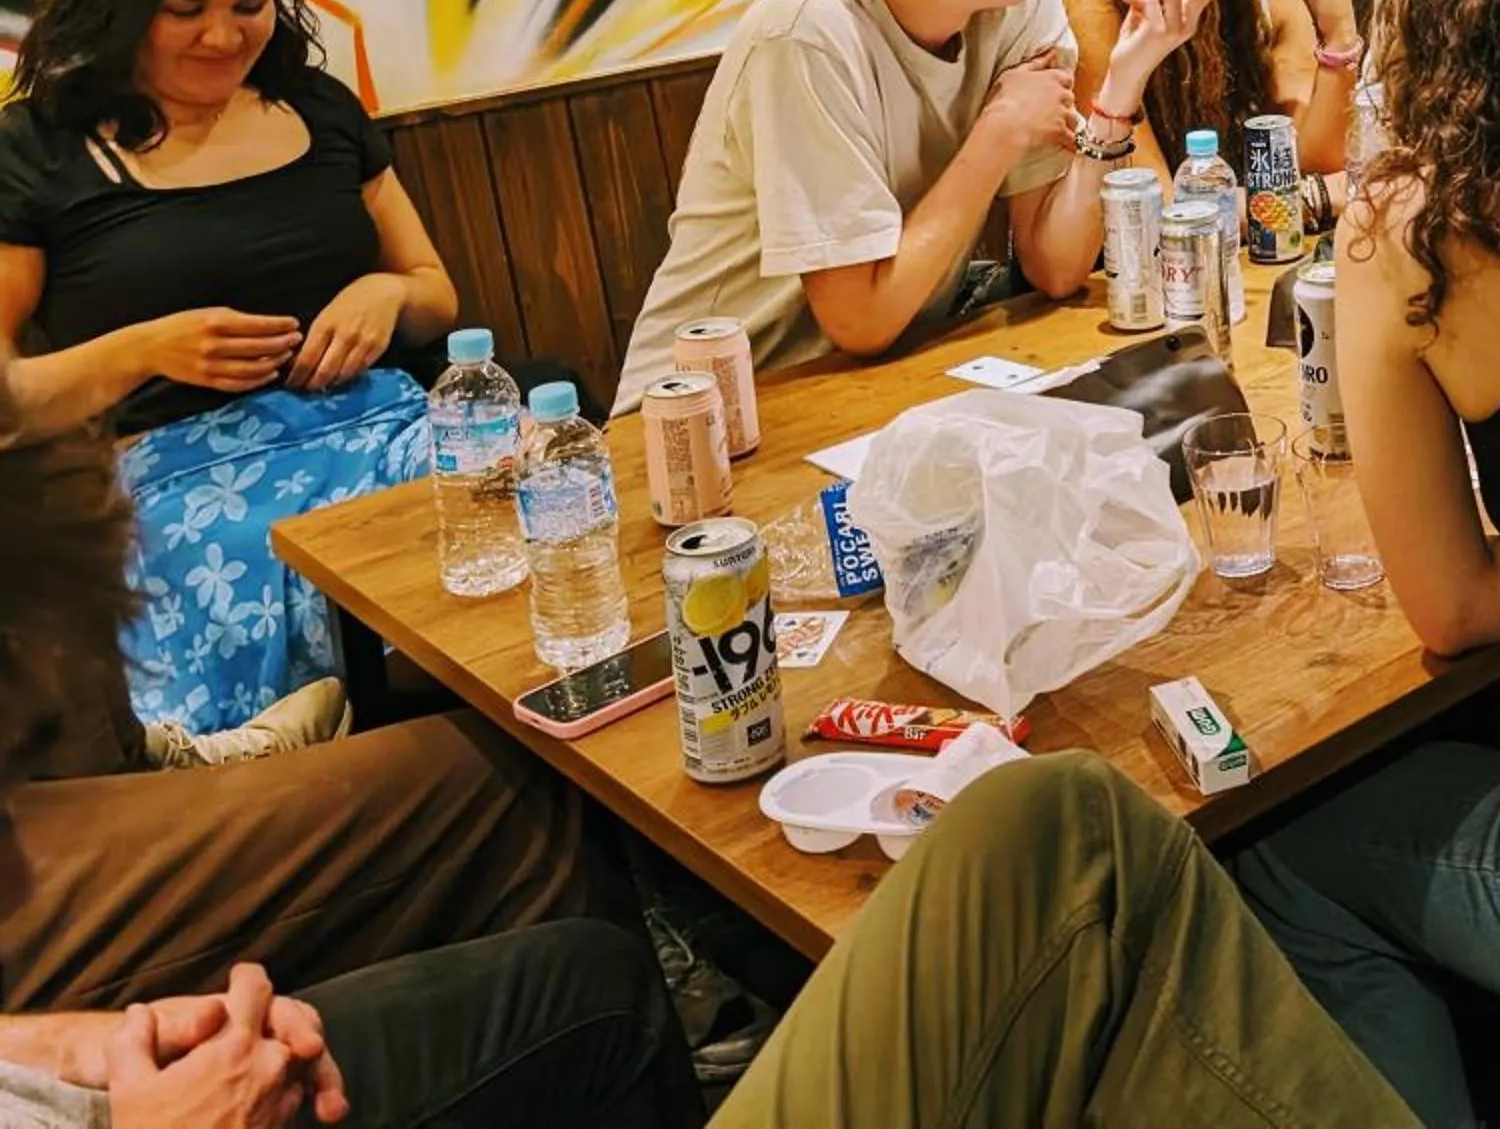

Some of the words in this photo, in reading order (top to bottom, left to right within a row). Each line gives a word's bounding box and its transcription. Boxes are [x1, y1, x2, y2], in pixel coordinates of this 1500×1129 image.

[832, 502, 863, 586] POCARI
[855, 534, 879, 582] SWE
[711, 676, 765, 714] STRONG
